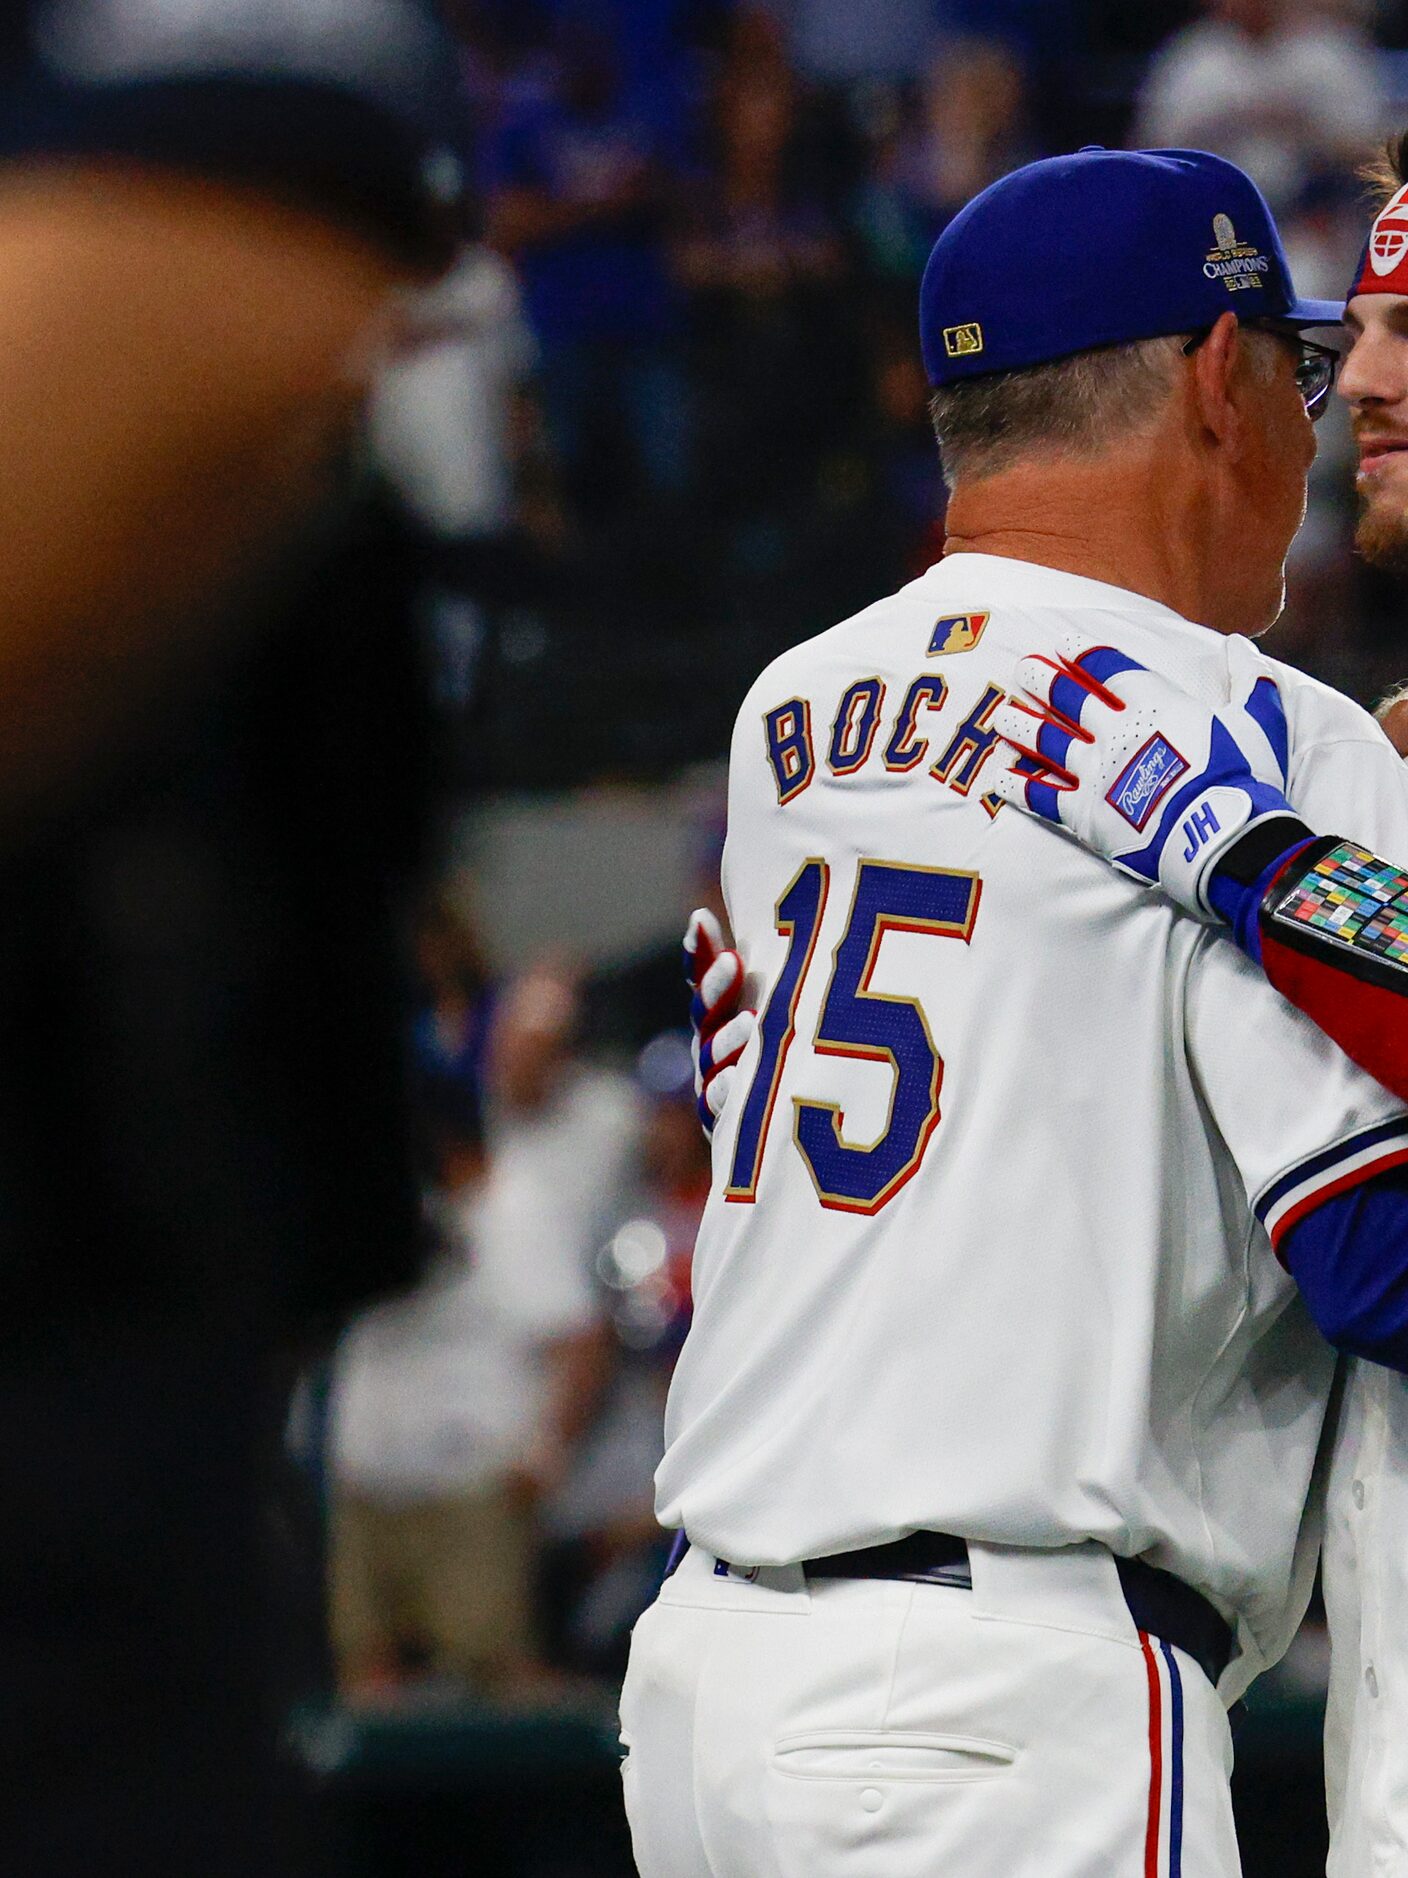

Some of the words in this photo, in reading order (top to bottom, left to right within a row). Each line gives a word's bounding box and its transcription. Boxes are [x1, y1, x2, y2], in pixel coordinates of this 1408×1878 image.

[1203, 256, 1269, 279] CHAMPIONS
[1122, 747, 1167, 815] Rawlings
[1183, 801, 1221, 863] JH
[723, 856, 983, 1216] 15
